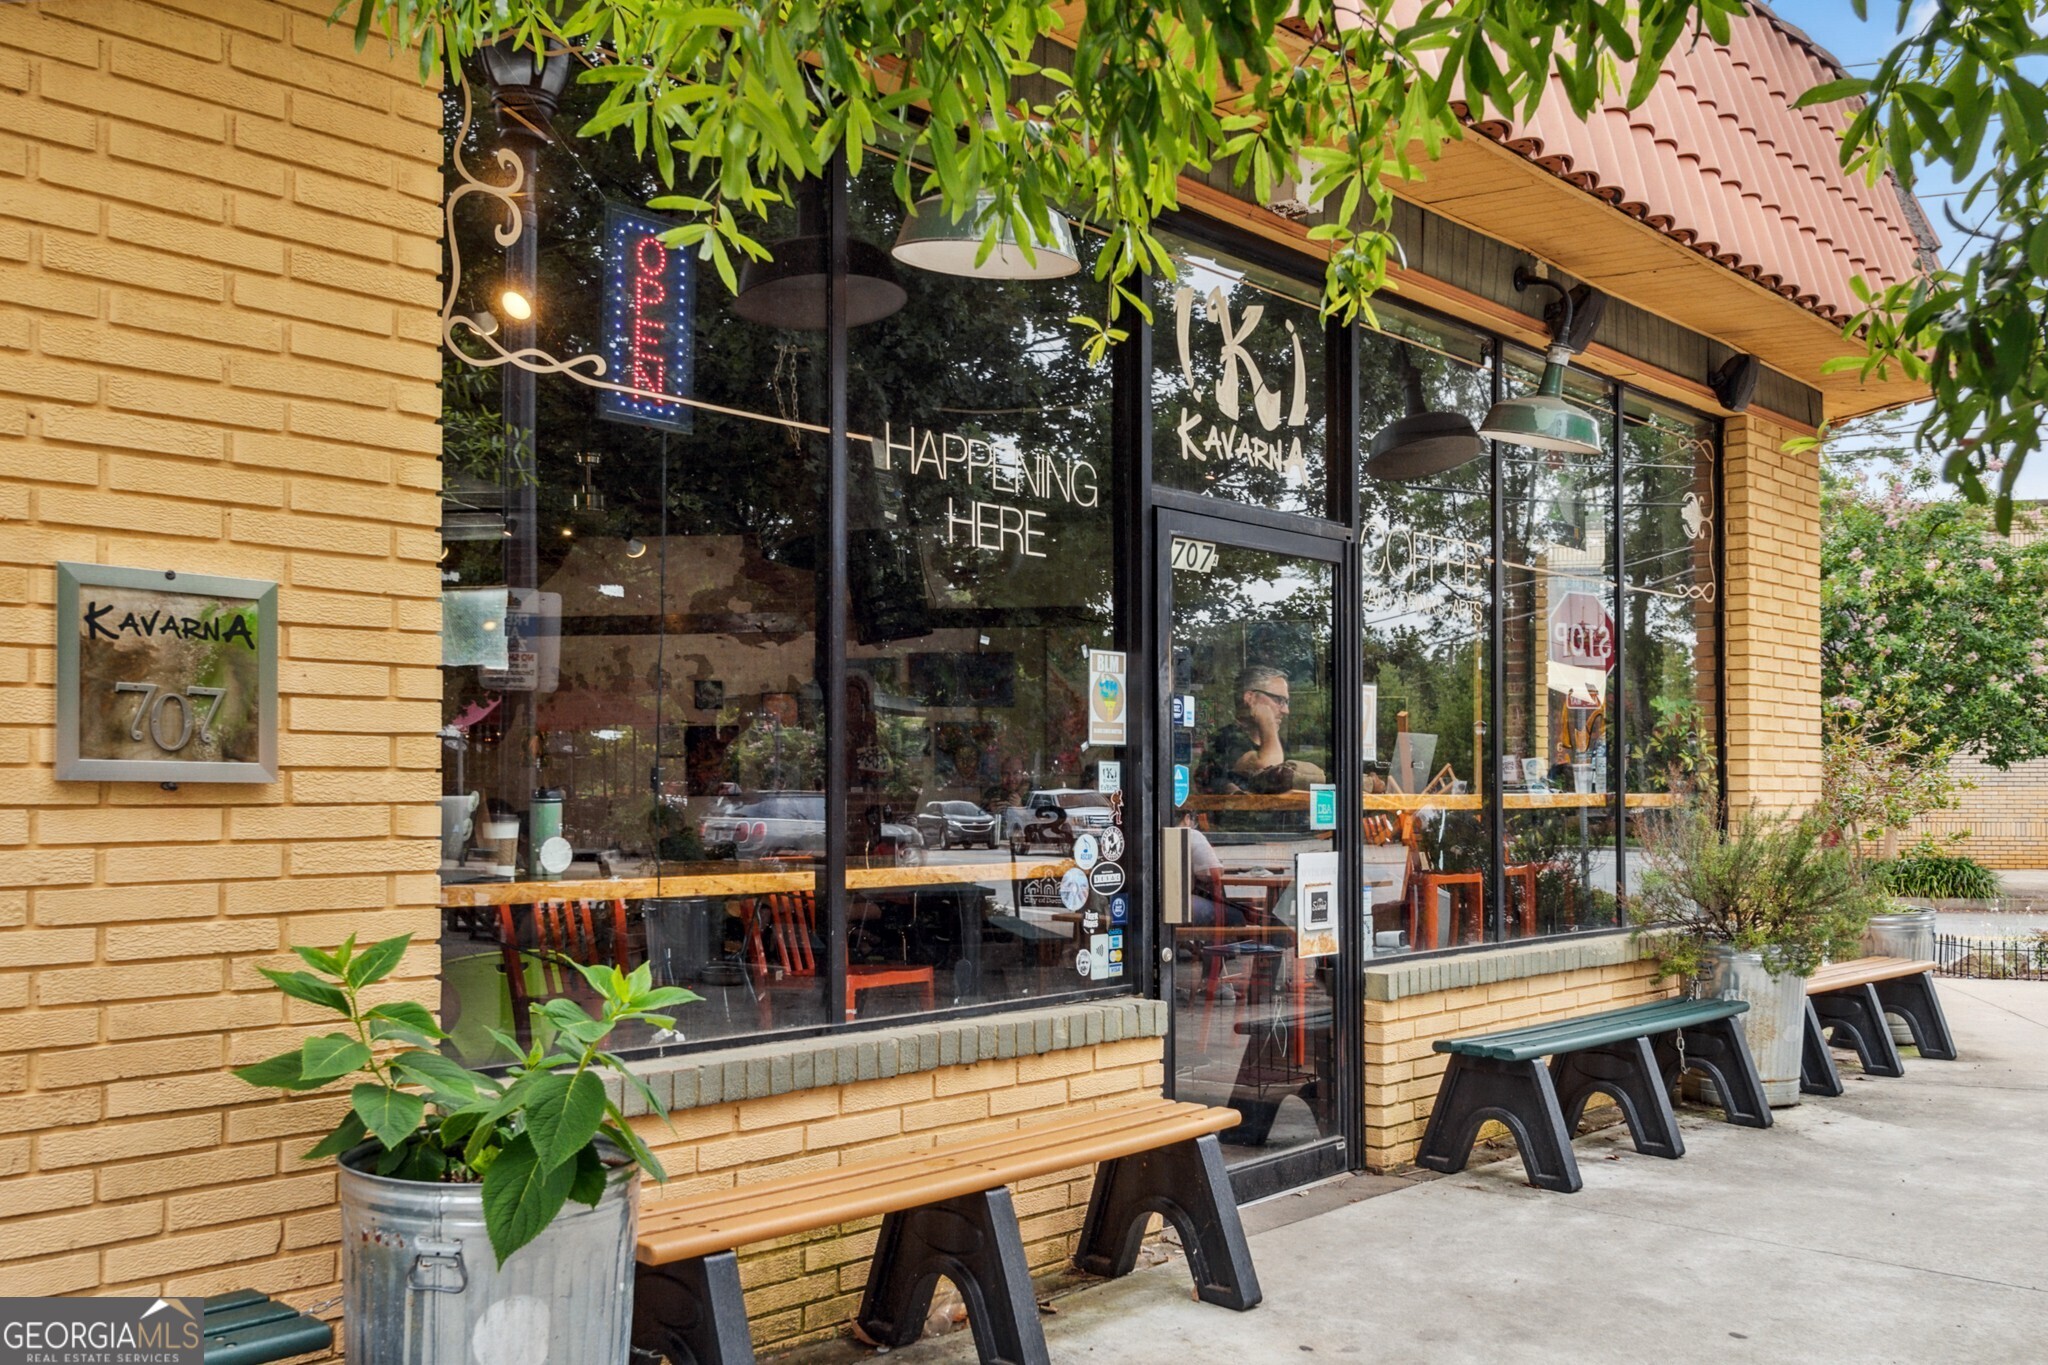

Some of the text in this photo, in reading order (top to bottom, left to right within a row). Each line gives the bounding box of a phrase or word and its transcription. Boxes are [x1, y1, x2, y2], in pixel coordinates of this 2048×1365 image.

[633, 236, 666, 406] OPEN
[885, 421, 1098, 508] HAPPENING
[1178, 408, 1309, 488] KAVARNA
[949, 497, 1047, 558] HERE
[1172, 541, 1213, 571] 707
[1361, 523, 1482, 593] COFFEE
[84, 601, 255, 650] KAVARNA
[1097, 654, 1120, 673] BLM
[115, 681, 226, 751] 707
[1317, 803, 1333, 815] DBA
